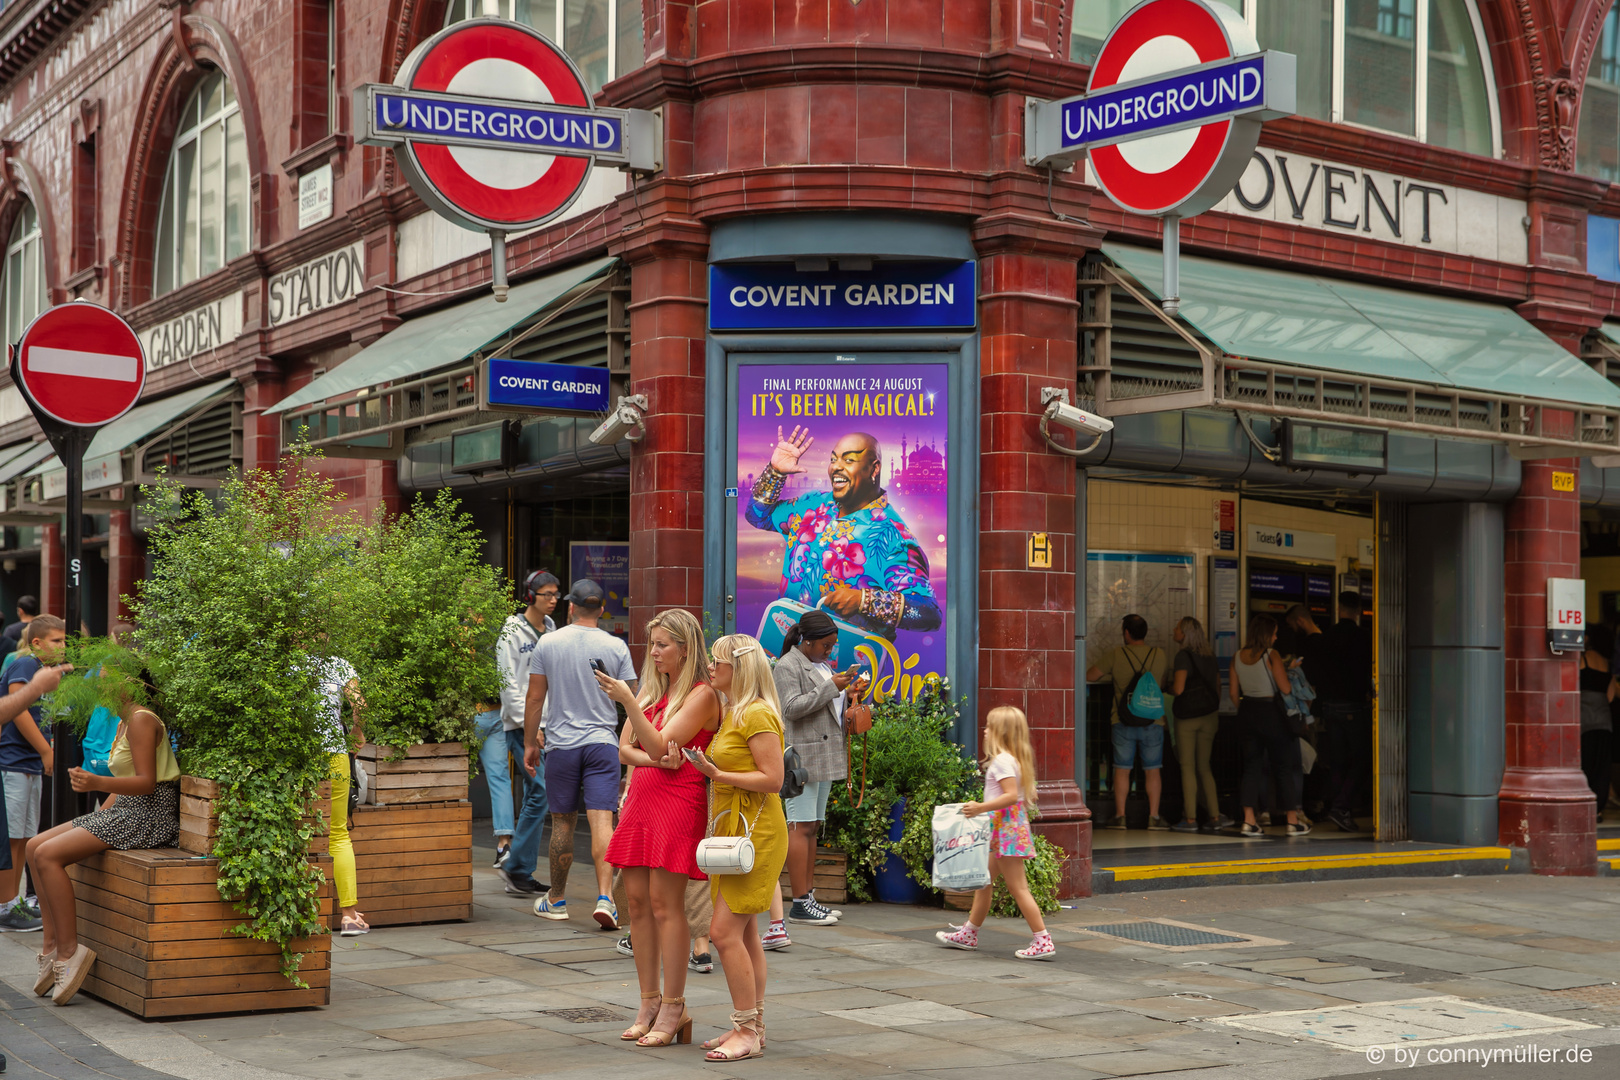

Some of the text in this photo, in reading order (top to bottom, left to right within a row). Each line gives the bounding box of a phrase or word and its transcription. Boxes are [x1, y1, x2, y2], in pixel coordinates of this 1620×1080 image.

[1065, 66, 1261, 140] UNDERGROUND
[382, 97, 615, 150] UNDERGROUND
[1233, 150, 1448, 243] OVENT
[150, 246, 364, 367] GARDEN STATION
[729, 283, 954, 307] COVENT GARDEN
[499, 376, 601, 395] COVENT GARDEN
[763, 378, 923, 391] FINAL PERFORMANCE 24 AUGUST
[752, 392, 934, 417] IT'S BEEN MAGICAL!
[1554, 475, 1573, 489] RVP
[1256, 531, 1276, 545] Tickets
[1558, 609, 1582, 624] LFB
